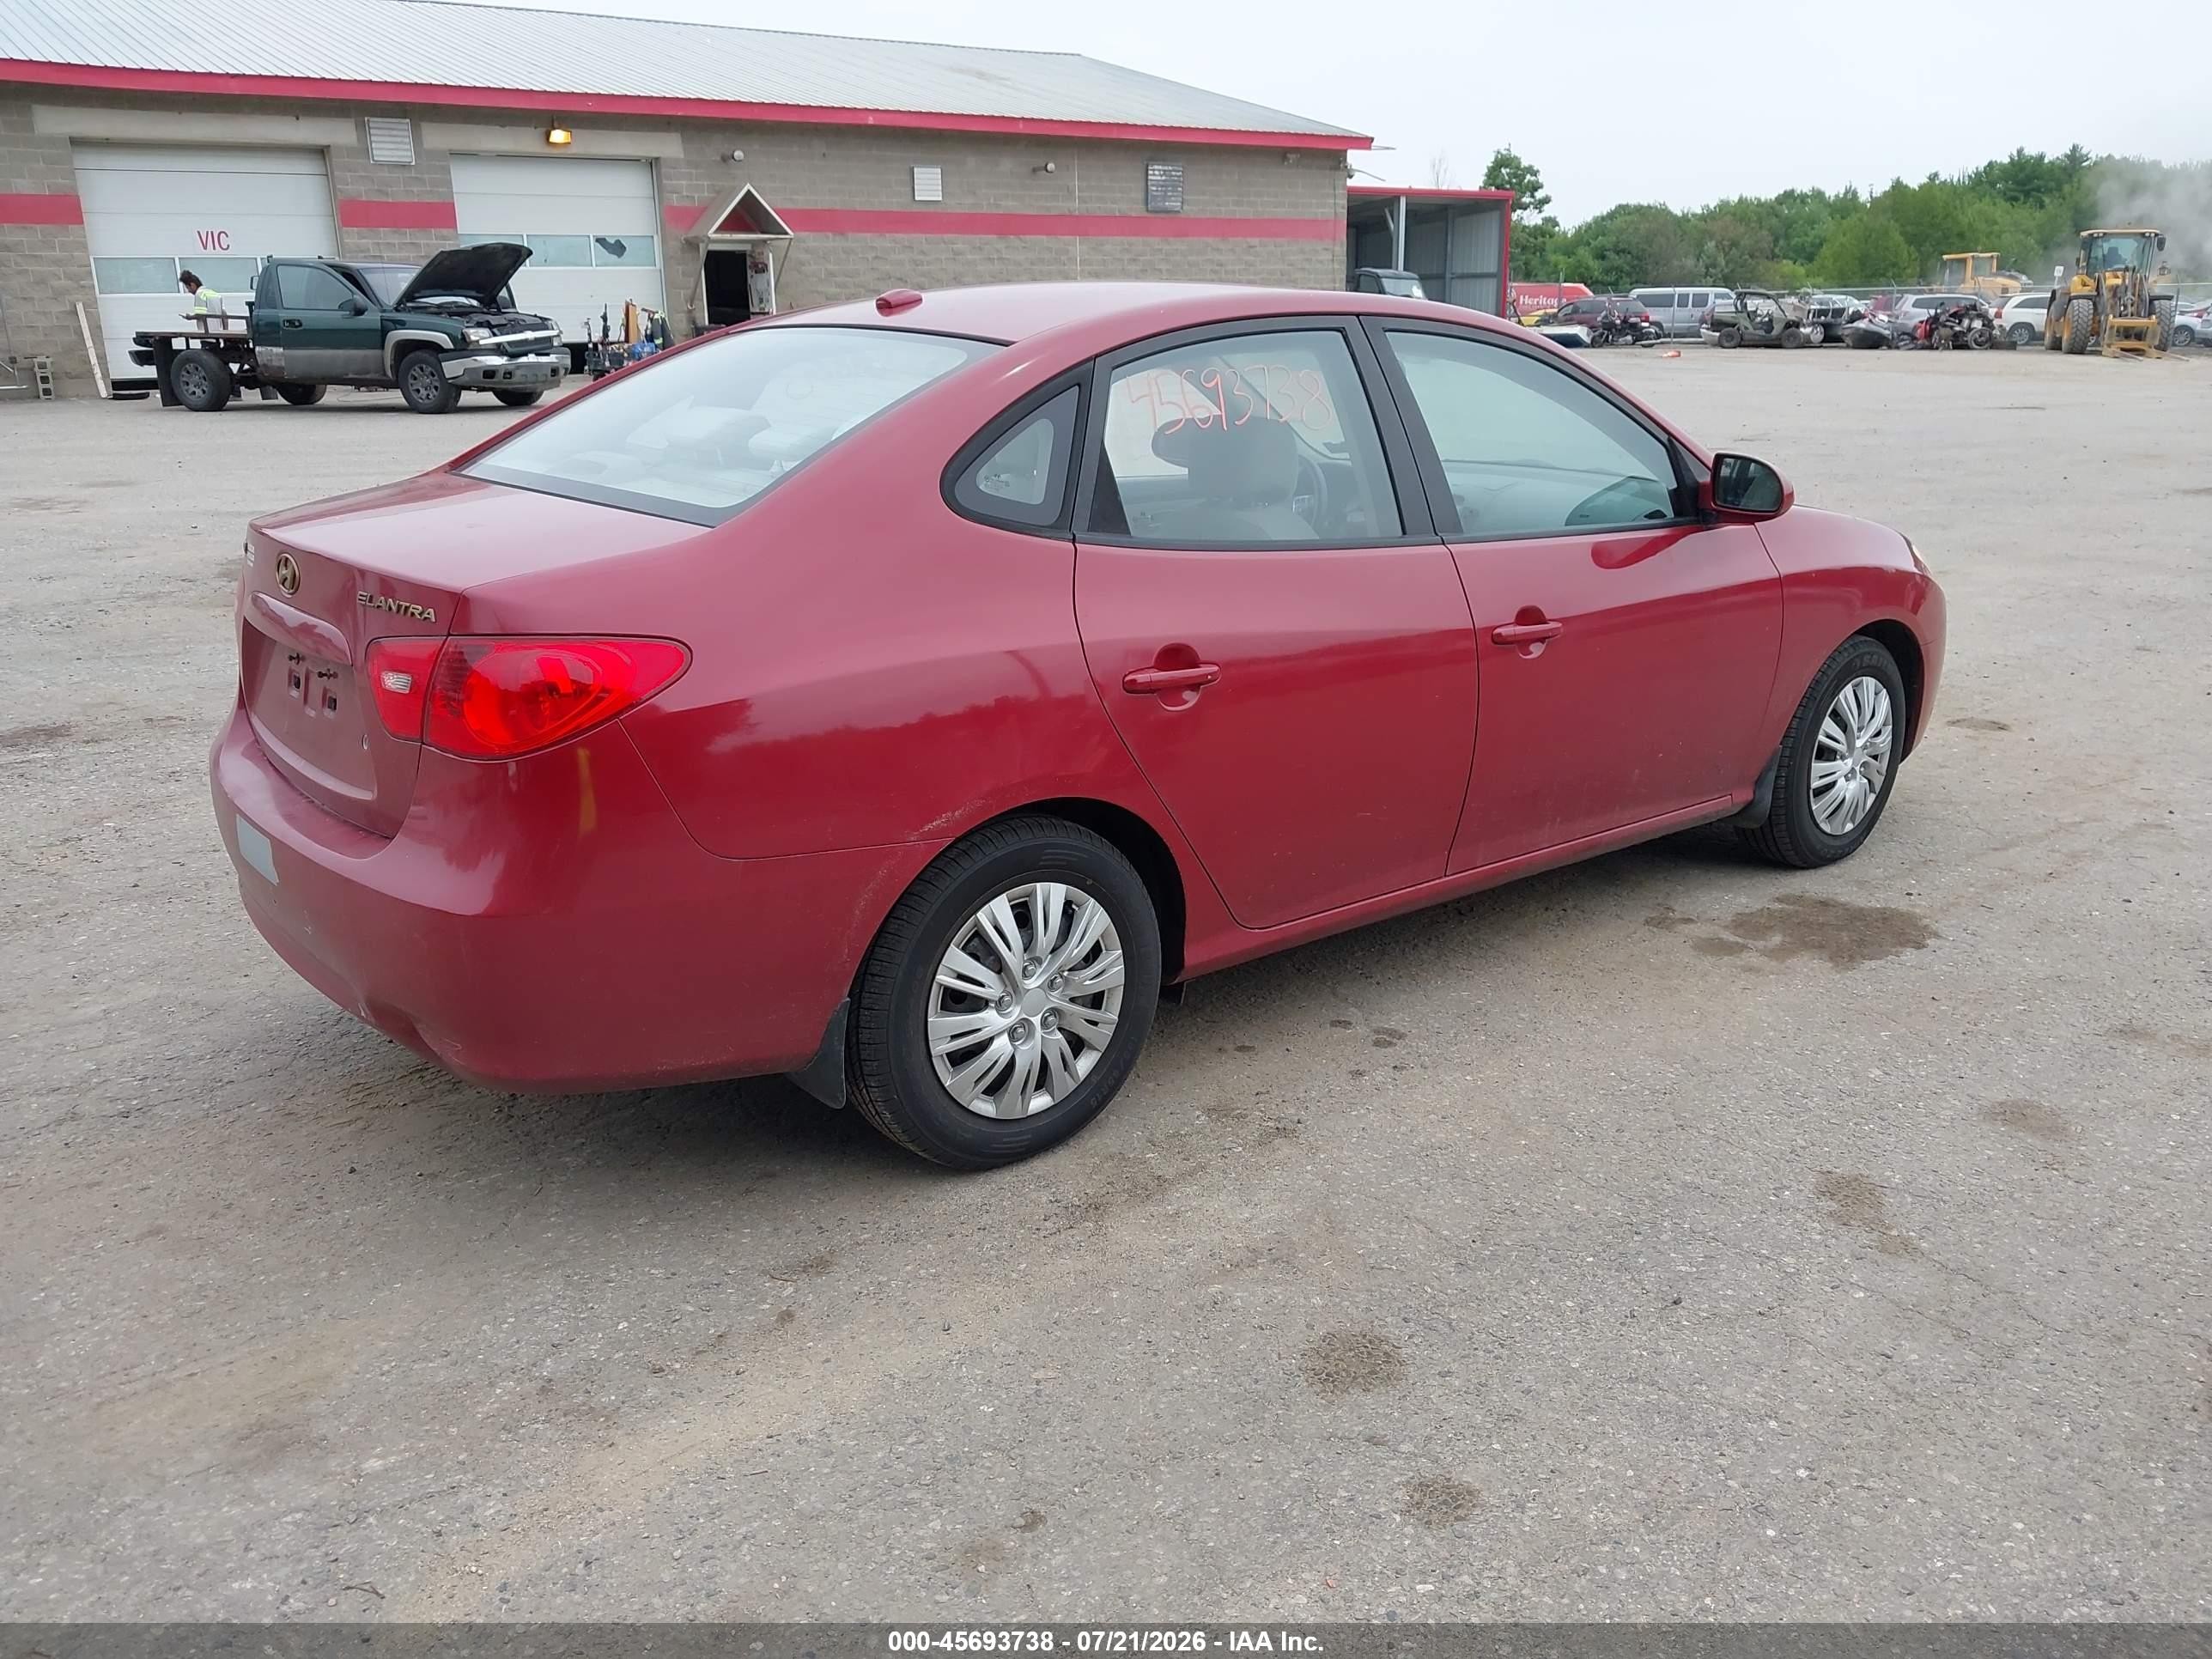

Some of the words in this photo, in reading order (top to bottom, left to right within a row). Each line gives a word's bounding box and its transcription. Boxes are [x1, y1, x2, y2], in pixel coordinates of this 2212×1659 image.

[197, 230, 230, 251] VIC
[1126, 363, 1332, 434] 45693738
[357, 590, 436, 623] ELANTRA
